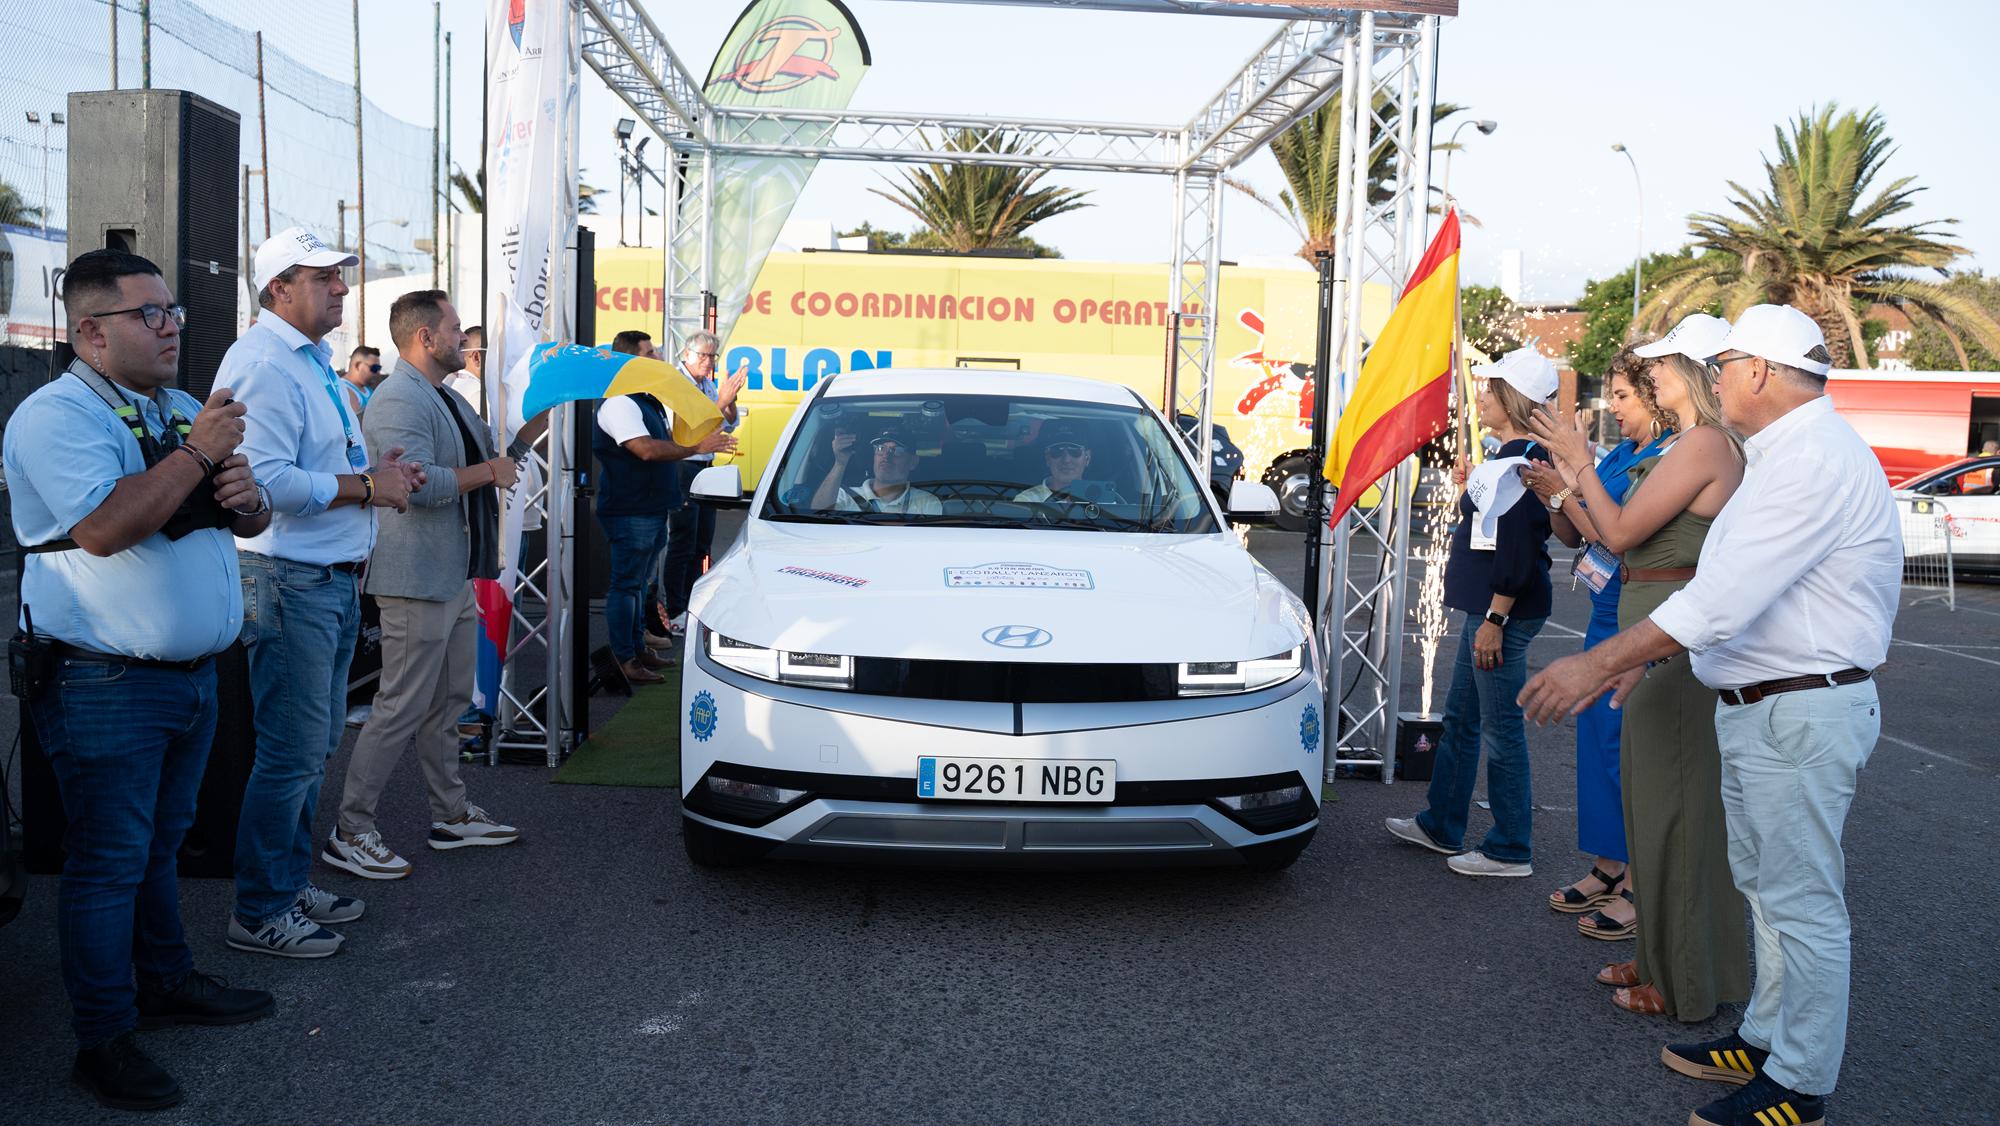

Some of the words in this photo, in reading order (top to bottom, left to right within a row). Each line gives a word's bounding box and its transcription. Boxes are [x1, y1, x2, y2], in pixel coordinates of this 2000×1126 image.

[595, 286, 664, 313] CENT
[790, 291, 1035, 323] COORDINACION
[1053, 299, 1218, 328] OPERATV
[923, 781, 931, 790] E
[942, 762, 1025, 795] 9261
[1041, 765, 1104, 796] NBG
